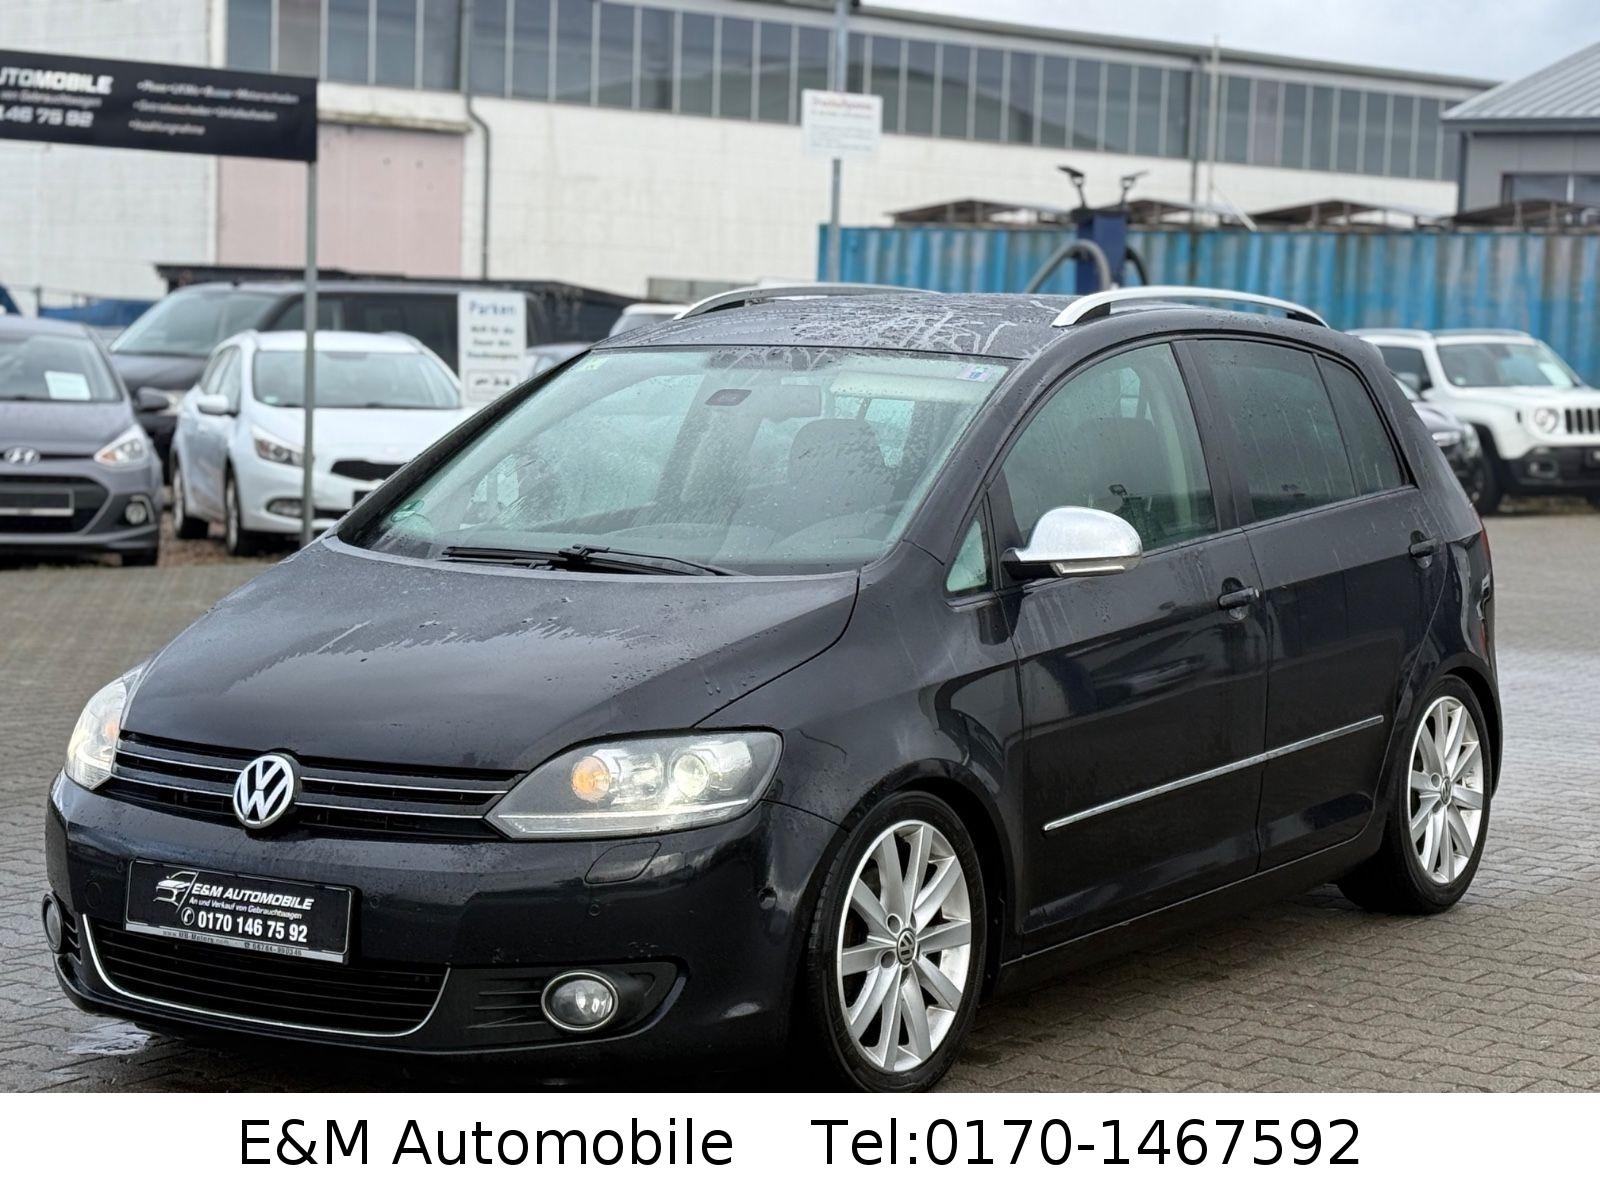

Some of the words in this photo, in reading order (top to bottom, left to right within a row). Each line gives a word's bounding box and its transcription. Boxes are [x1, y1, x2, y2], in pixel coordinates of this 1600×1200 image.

[189, 896, 198, 905] An
[199, 898, 211, 907] und
[211, 900, 236, 910] Verkauf
[236, 904, 247, 912] von
[247, 905, 303, 920] Gebrauchtwagen
[191, 883, 224, 898] E&M
[223, 888, 315, 910] AUTOMOBILE
[198, 911, 232, 932] 0170
[236, 916, 263, 936] 146
[266, 920, 286, 939] 75
[289, 924, 308, 943] 92
